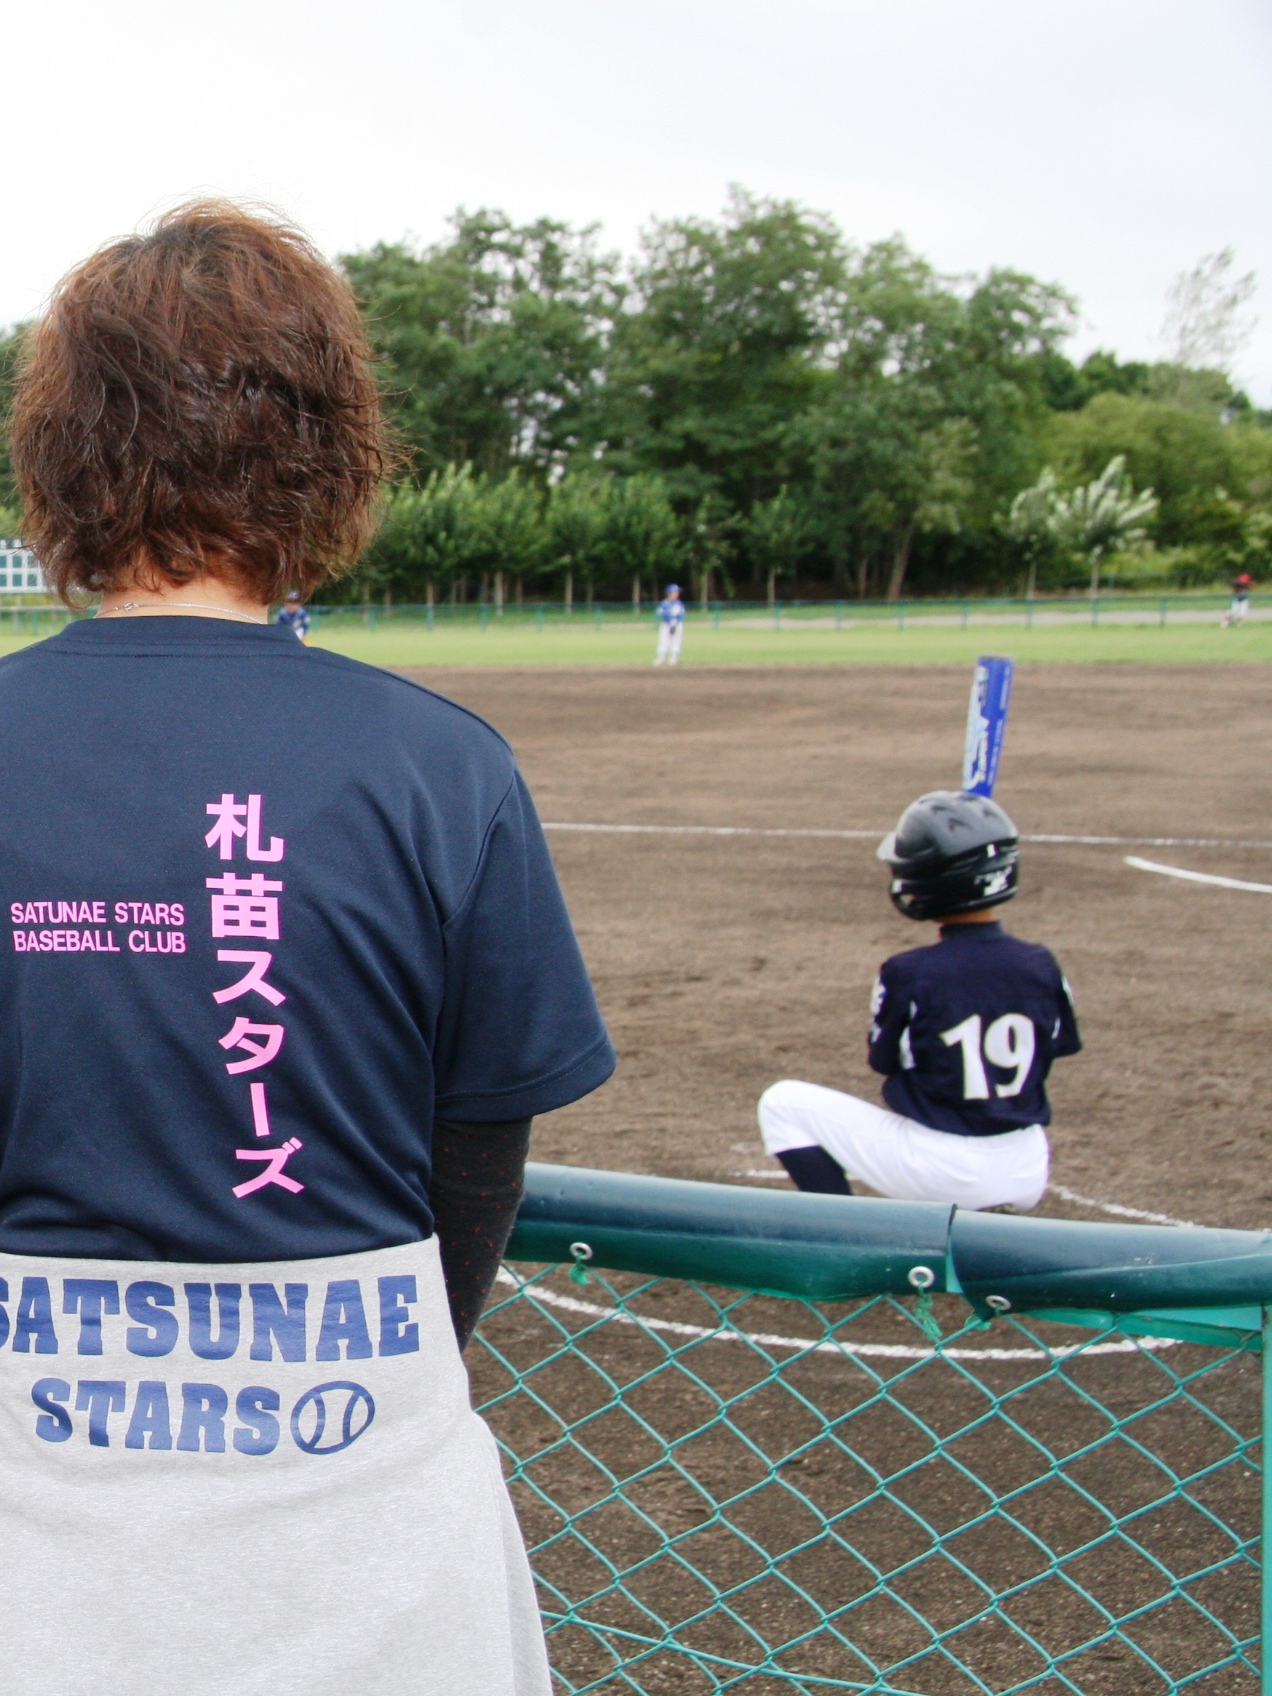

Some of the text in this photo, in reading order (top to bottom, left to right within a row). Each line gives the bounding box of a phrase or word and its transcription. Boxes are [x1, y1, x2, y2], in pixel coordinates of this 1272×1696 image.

[11, 901, 185, 926] SATUNAE STARS
[12, 929, 187, 954] BASEBALL CLUB
[205, 793, 304, 1199] 札苗スターズ
[940, 1012, 1036, 1100] 19
[31, 1377, 281, 1457] STARS
